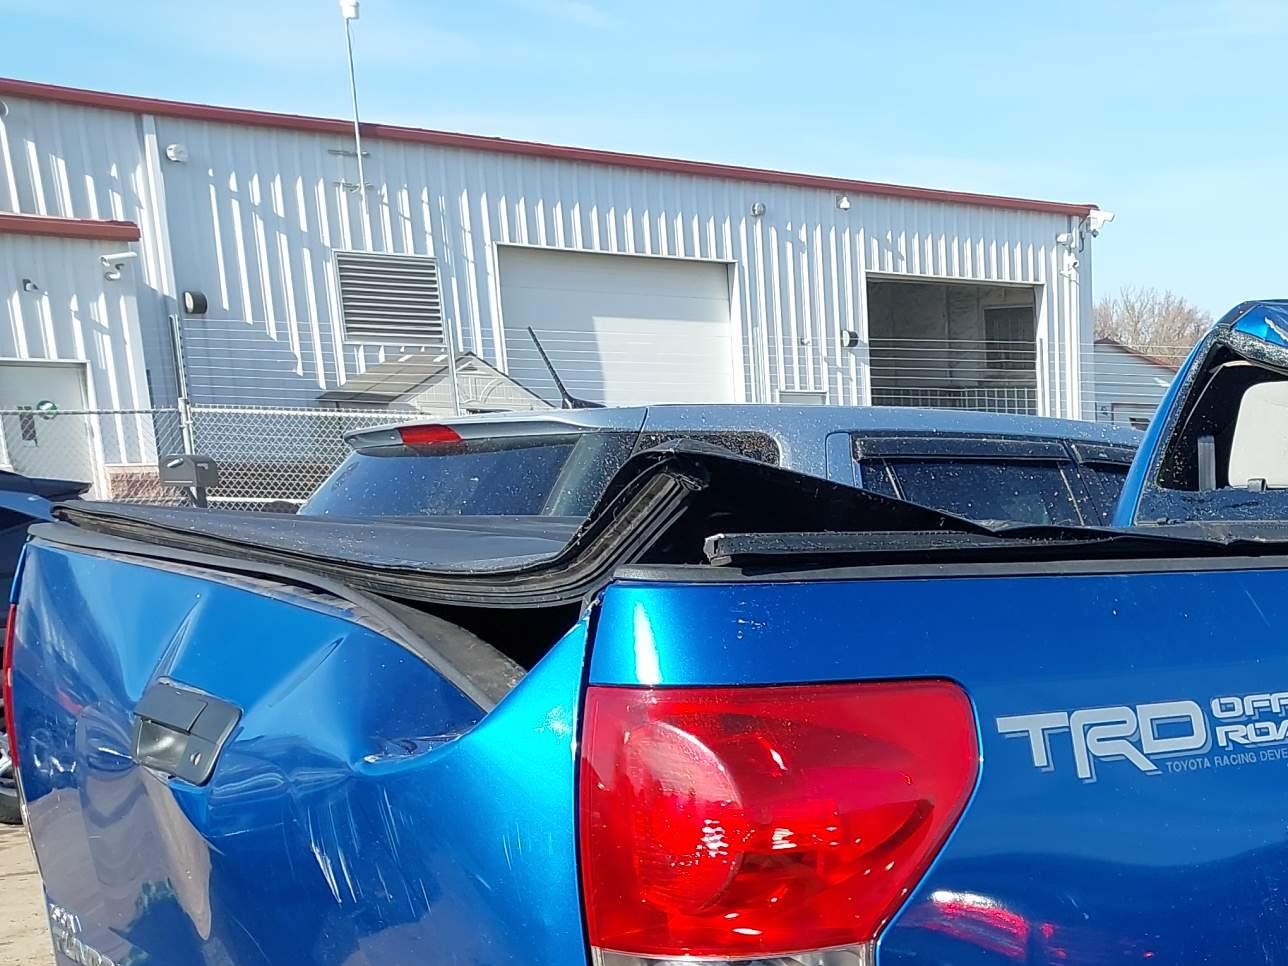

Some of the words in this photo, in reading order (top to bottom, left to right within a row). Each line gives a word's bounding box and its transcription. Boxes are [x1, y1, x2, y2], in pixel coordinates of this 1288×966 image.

[996, 699, 1211, 782] TRD
[1166, 757, 1211, 774] TOYOTA
[1213, 751, 1257, 769] RACING
